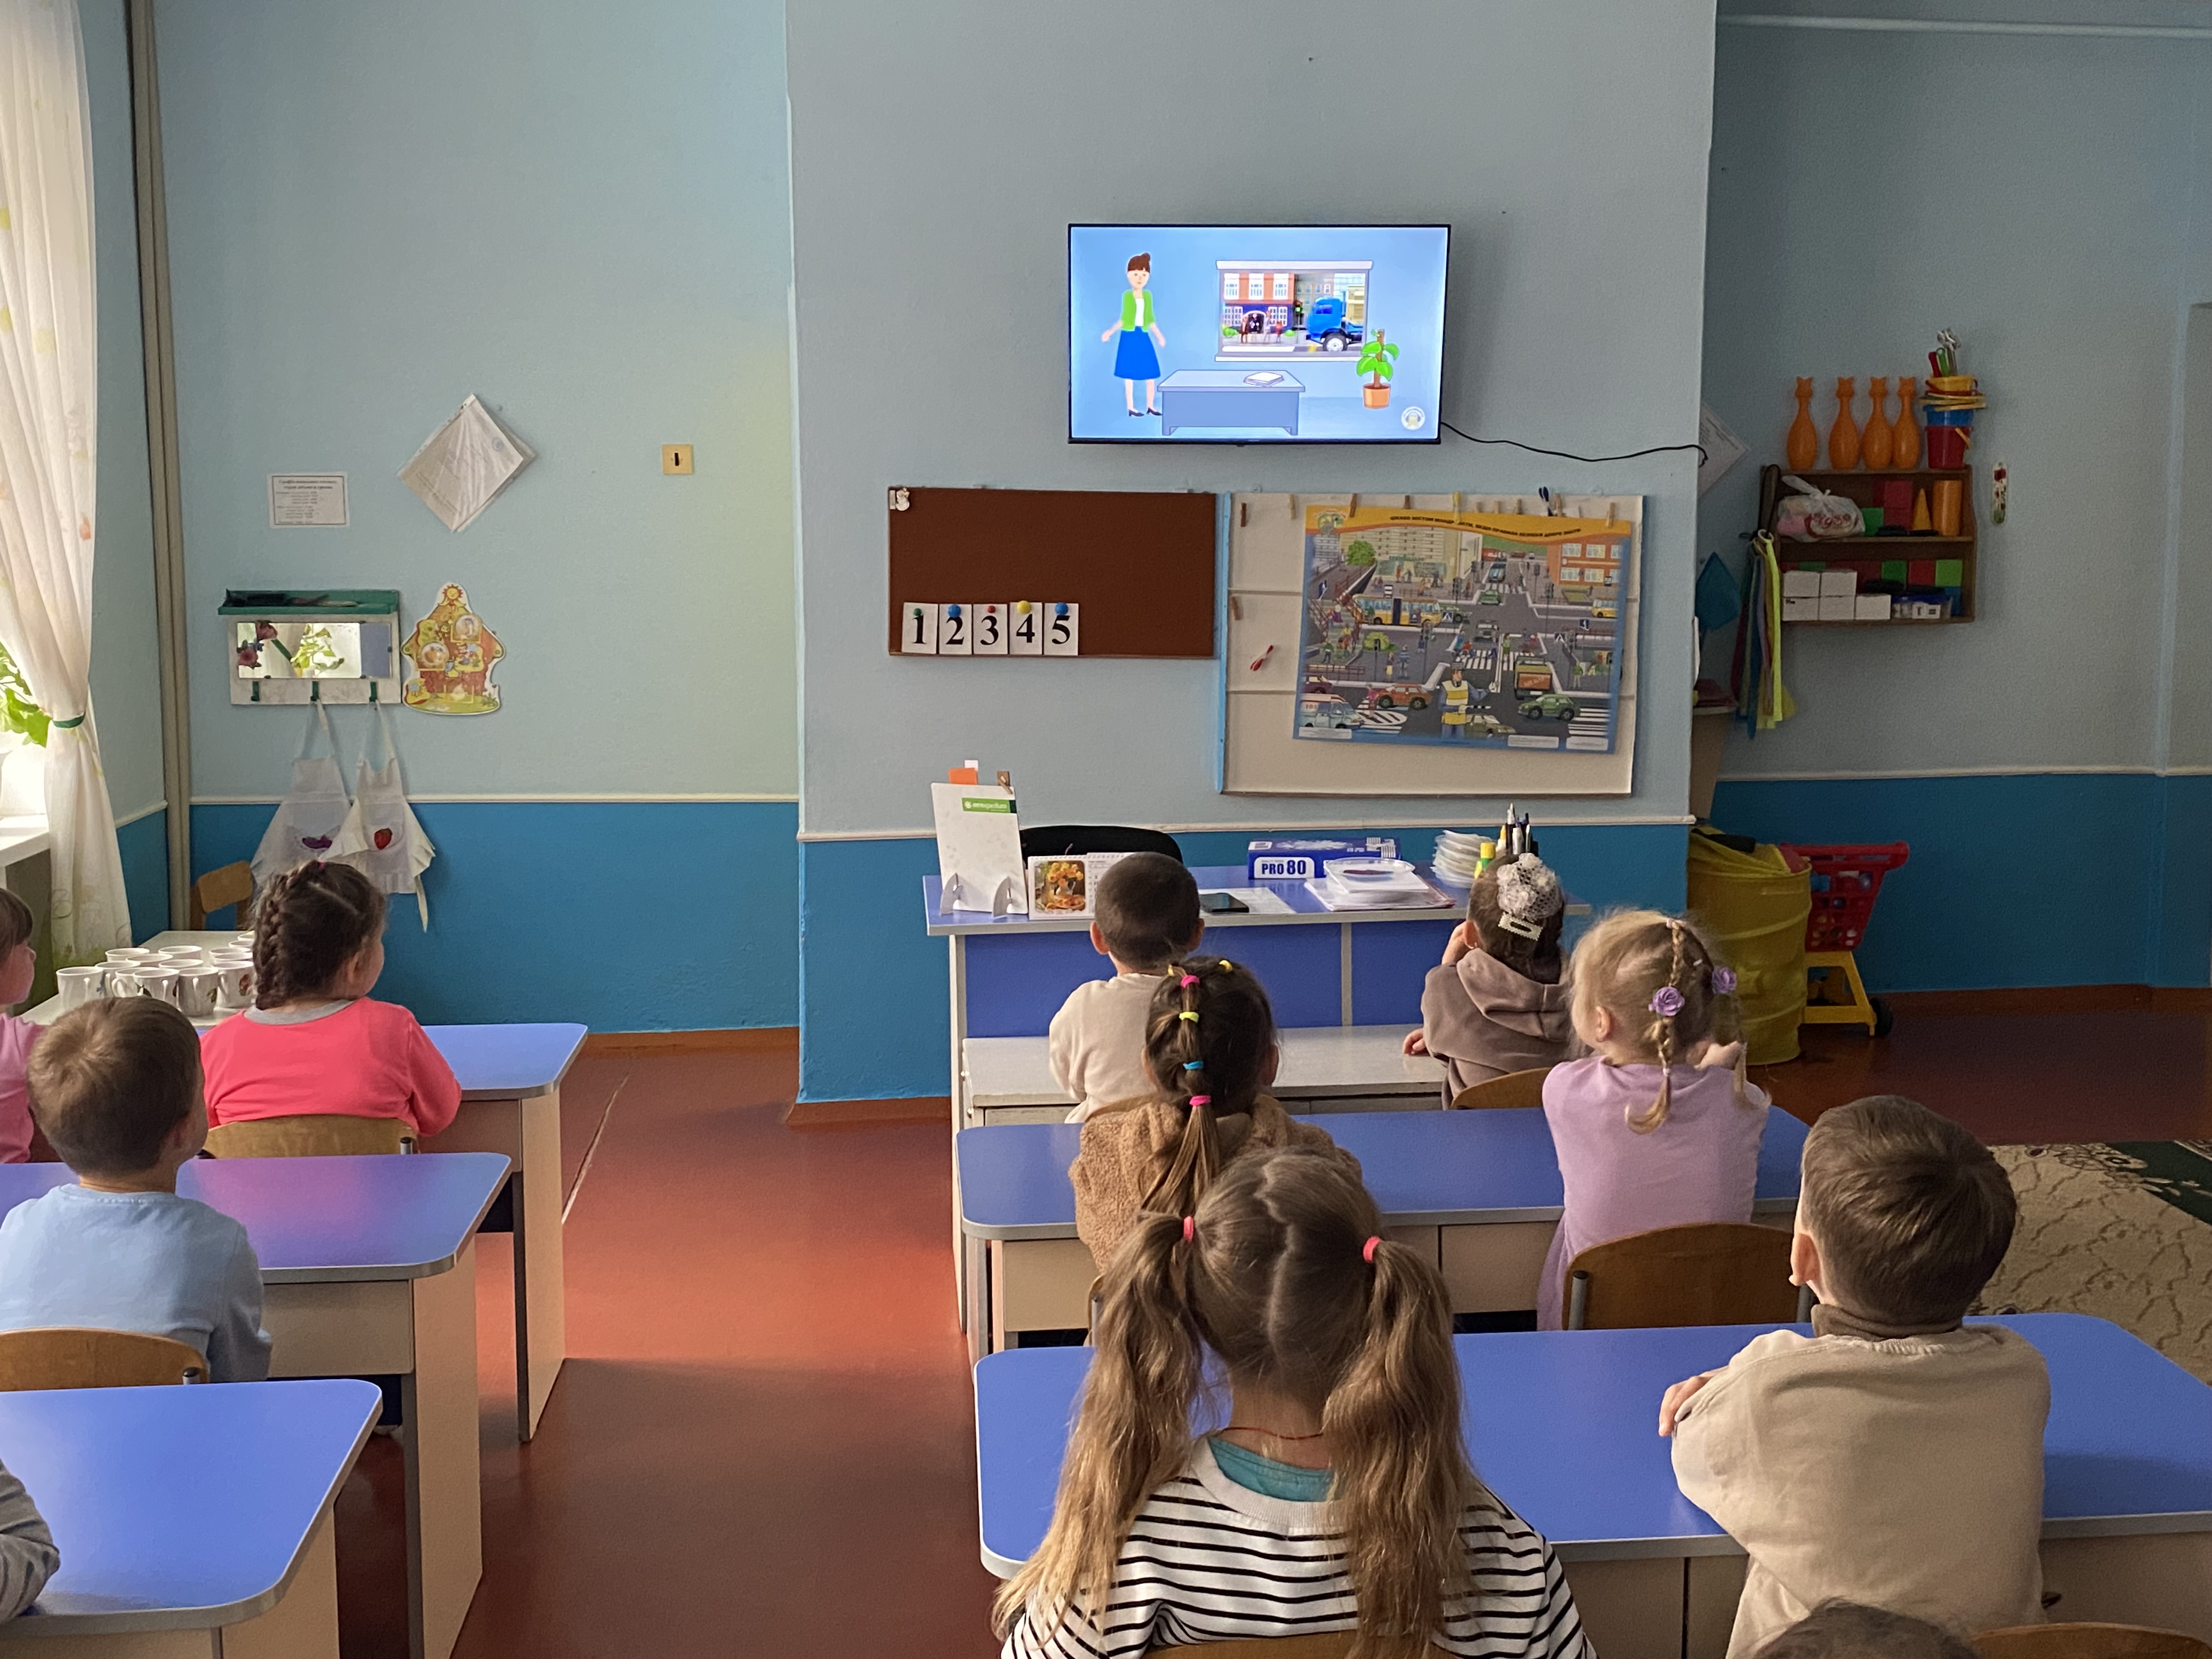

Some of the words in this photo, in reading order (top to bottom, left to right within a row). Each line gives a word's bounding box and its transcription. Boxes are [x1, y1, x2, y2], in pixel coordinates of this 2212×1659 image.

[912, 615, 927, 644] 1
[946, 616, 964, 645] 2
[980, 615, 999, 645] 3
[1016, 614, 1035, 643] 4
[1052, 614, 1070, 644] 5
[1262, 863, 1284, 875] PRO
[1287, 860, 1306, 875] 80
